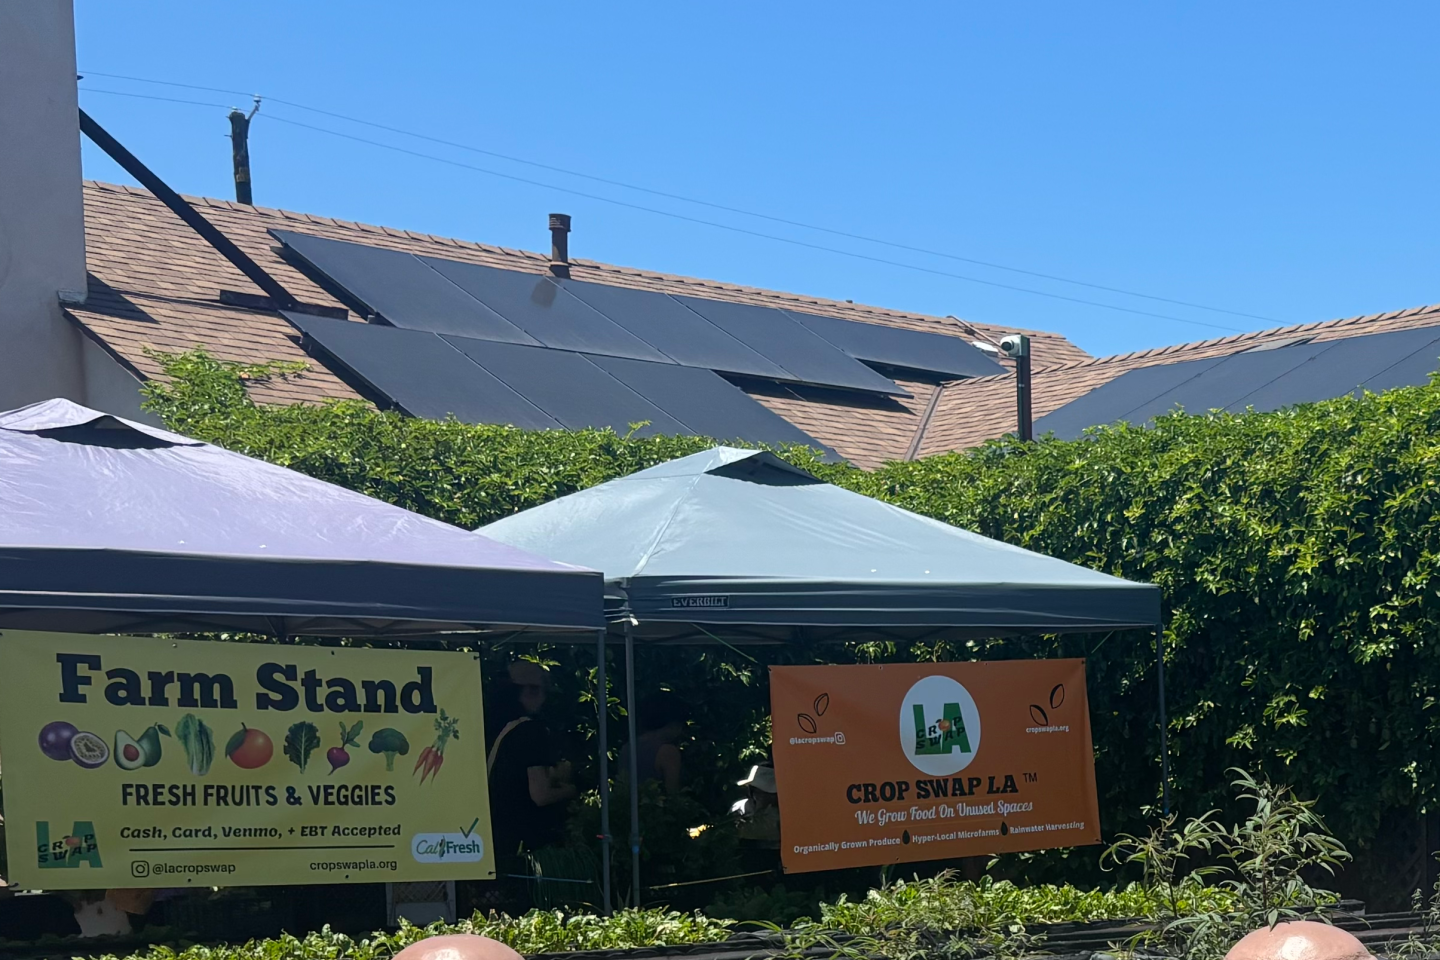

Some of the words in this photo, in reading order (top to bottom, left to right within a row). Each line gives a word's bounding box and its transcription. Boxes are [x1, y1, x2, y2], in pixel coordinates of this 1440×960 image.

[673, 596, 727, 607] EVERBILT
[55, 652, 238, 710] Farm
[255, 662, 438, 714] Stand
[1025, 725, 1070, 735] cropswapla.org
[789, 736, 835, 746] @lacropswap
[121, 783, 197, 806] FRESH
[203, 783, 279, 807] FRUITS
[285, 785, 303, 806] &
[307, 784, 396, 806] VEGGIES
[846, 780, 910, 804] CROP
[915, 776, 982, 800] SWAP
[986, 774, 1019, 795] LA
[854, 810, 875, 825] We
[877, 808, 908, 827] Grow
[909, 805, 937, 821] Food
[938, 803, 956, 818] On
[956, 802, 996, 816] Unused
[997, 800, 1034, 817] Spaces
[120, 826, 168, 840] Cash,
[172, 825, 218, 840] Card,
[222, 826, 283, 840] Venmo,
[300, 826, 327, 837] EBT
[331, 824, 401, 838] Accepted
[793, 842, 840, 855] Organically
[841, 840, 868, 850] Grown
[869, 837, 901, 847] Produce
[912, 831, 956, 844] Hyper-Local
[957, 829, 1000, 839] Microfarms
[1009, 826, 1045, 835] Rainwater
[1045, 821, 1085, 831] Harvesting
[152, 862, 236, 875] @lacropswap
[309, 859, 398, 872] cropswapla.org
